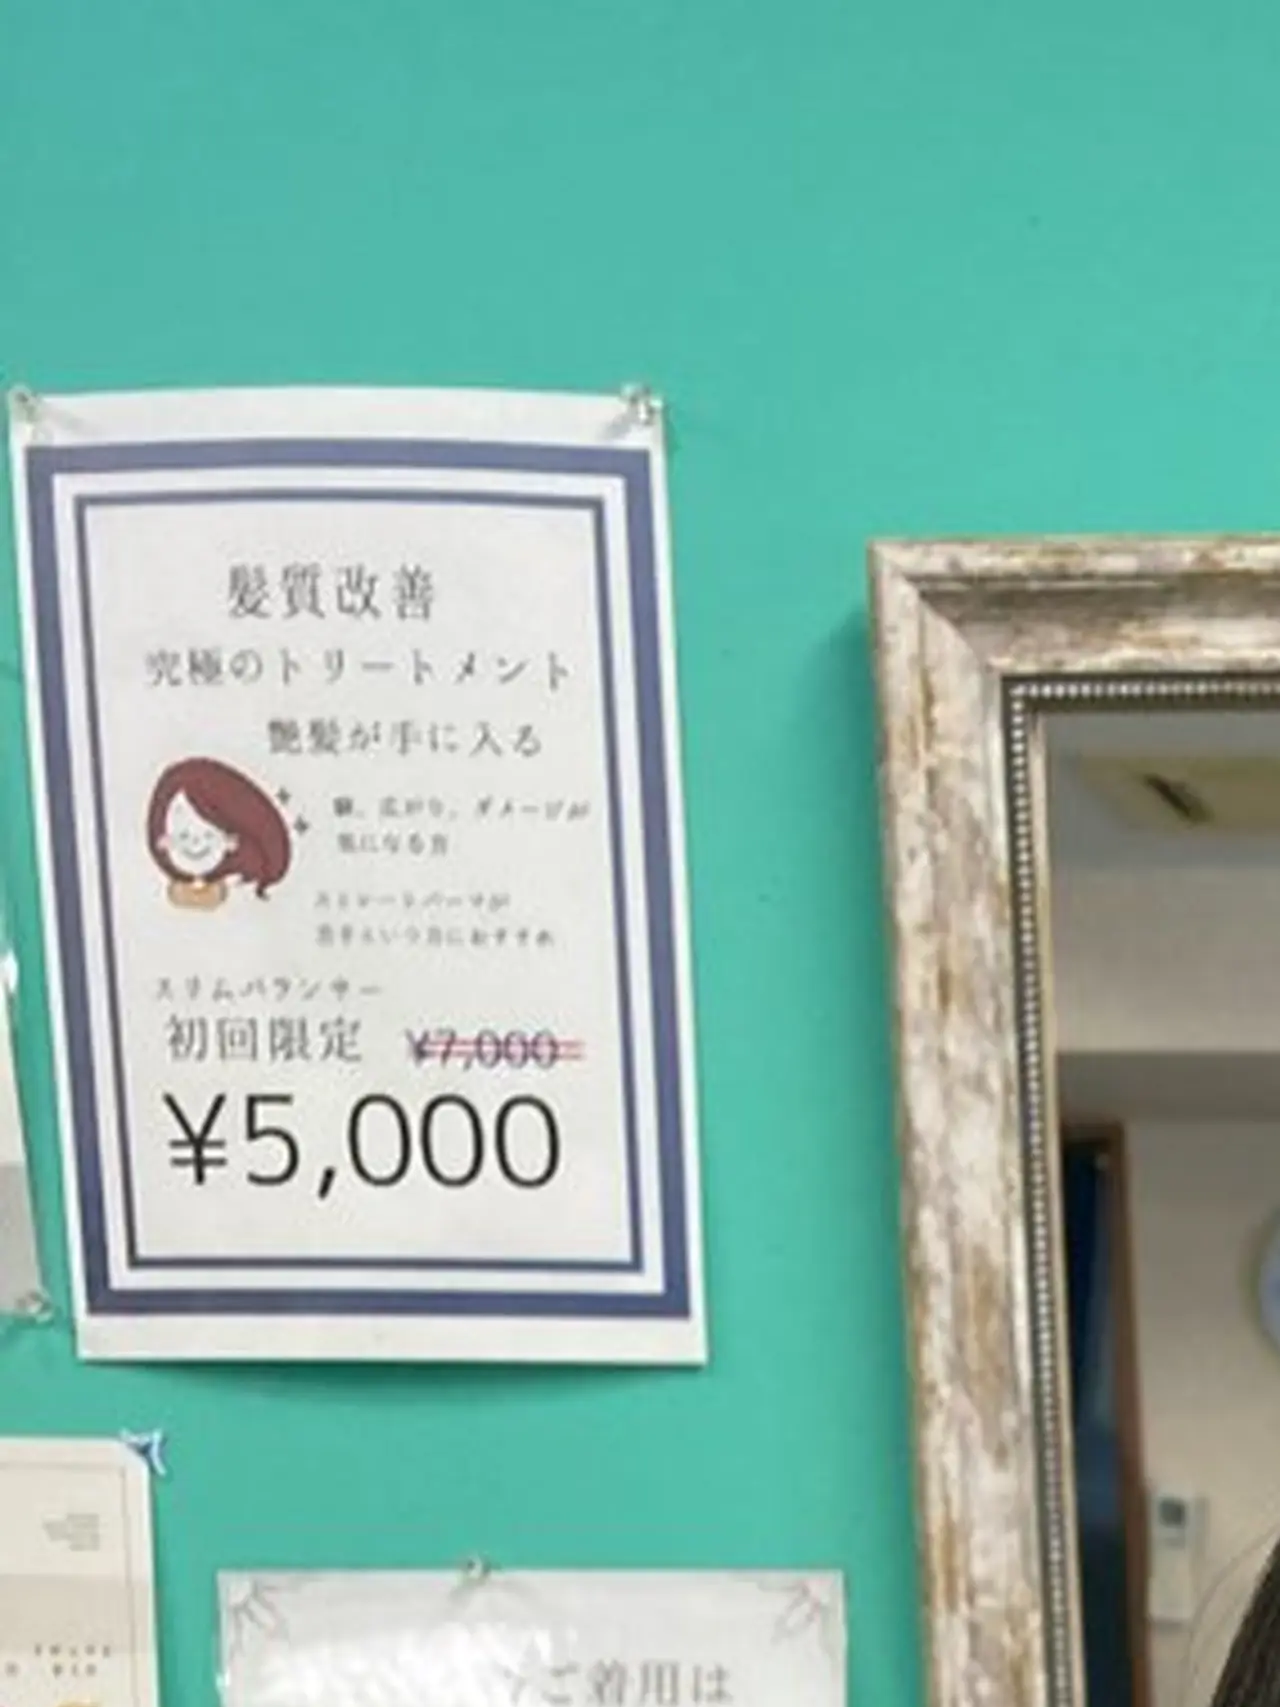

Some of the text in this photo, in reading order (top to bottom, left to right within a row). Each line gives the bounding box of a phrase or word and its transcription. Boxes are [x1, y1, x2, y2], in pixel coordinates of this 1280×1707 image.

[228, 565, 434, 622] 髪質改善
[144, 648, 570, 692] 究極のトリートメント
[267, 720, 541, 757] 艶髪が手に入る
[165, 1013, 363, 1063] 初回限定
[162, 1092, 562, 1199] ¥5,000
